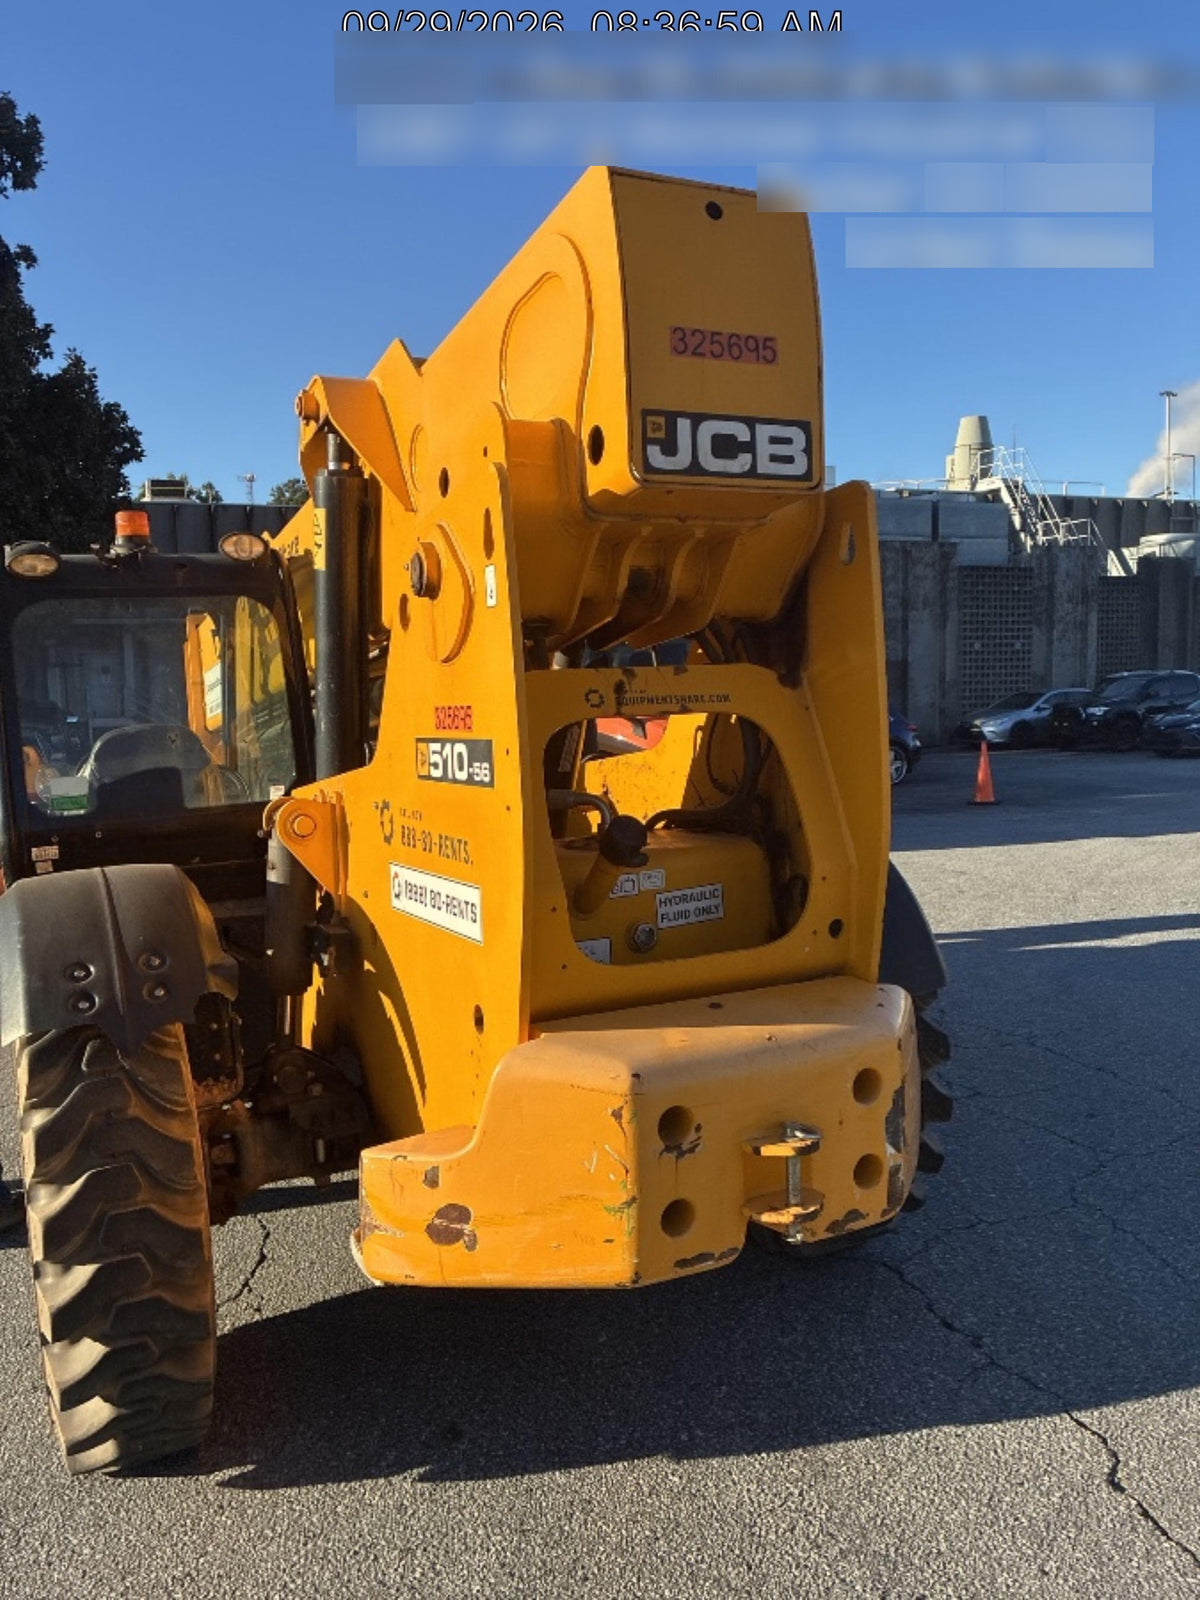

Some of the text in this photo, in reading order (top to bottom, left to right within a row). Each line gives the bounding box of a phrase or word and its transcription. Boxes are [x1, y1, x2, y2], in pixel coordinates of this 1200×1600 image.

[672, 327, 777, 363] 325695
[647, 417, 808, 476] JCB
[659, 889, 720, 907] HYDRAULIC
[661, 904, 720, 924] FLUID ONLY
